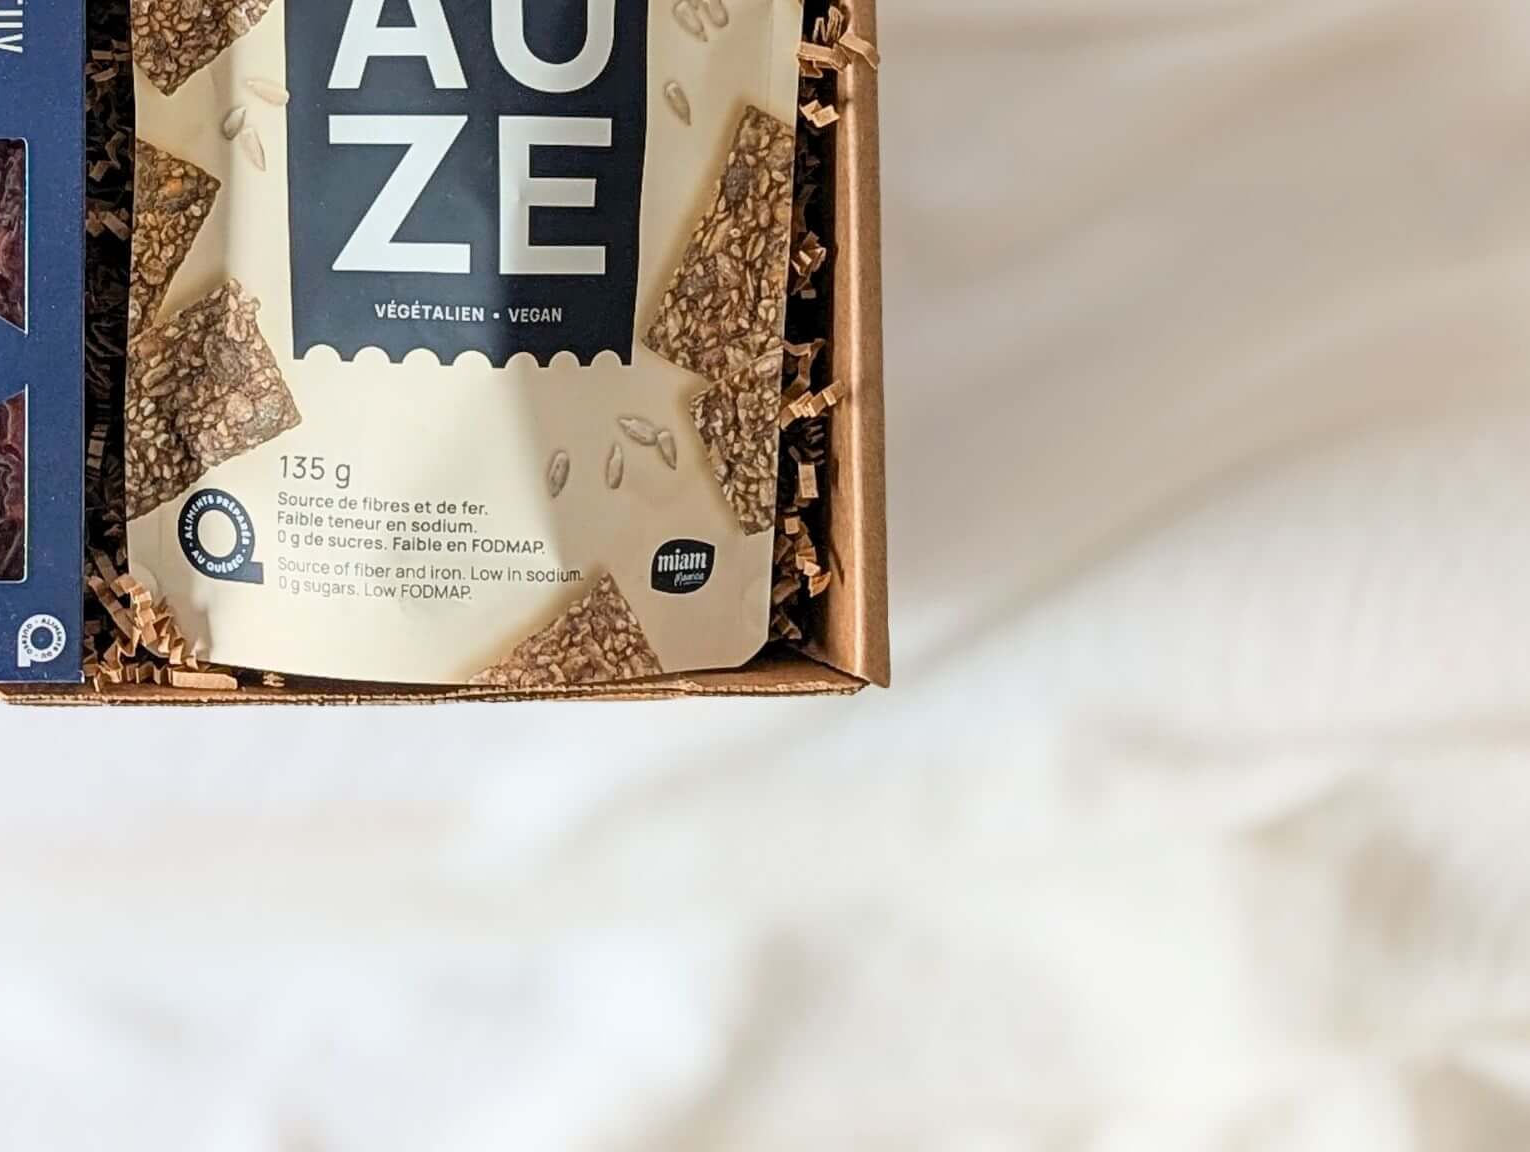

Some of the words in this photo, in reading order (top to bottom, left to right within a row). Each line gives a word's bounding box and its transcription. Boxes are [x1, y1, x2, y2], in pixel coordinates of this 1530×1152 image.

[328, 114, 613, 275] ZE
[374, 300, 484, 322] VÉGÉTALIEN
[508, 307, 562, 323] VEGAN
[280, 455, 325, 480] 135
[335, 463, 351, 489] g
[278, 491, 334, 509] Source
[338, 496, 358, 510] de
[362, 497, 410, 513] fibres
[414, 501, 432, 514] et
[436, 501, 457, 514] de
[462, 501, 488, 515] fer.
[185, 495, 214, 539] ALIMENTS
[216, 496, 251, 545] PRÉPARÉS
[278, 510, 324, 527] Faible
[328, 515, 382, 530] teneur
[386, 520, 406, 532] en
[411, 519, 478, 533] sodium.
[278, 529, 286, 543] 0
[290, 534, 300, 548] g
[304, 532, 324, 546] de
[328, 536, 387, 550] sucres.
[392, 536, 442, 551] Faible
[446, 540, 467, 552] en
[471, 539, 545, 554] FODMAP.
[191, 550, 205, 564] AU
[206, 554, 244, 573] QUÉBEC
[278, 556, 330, 575] Source
[334, 561, 351, 576] of
[354, 562, 391, 578] fiber
[395, 565, 426, 579] and
[431, 565, 466, 581] iron.
[471, 566, 503, 581] Low
[508, 567, 522, 581] in
[526, 568, 584, 583] sodium.
[657, 548, 707, 573] miam
[279, 575, 287, 589] 0
[291, 579, 300, 595] g
[303, 580, 360, 597] sugars.
[364, 582, 396, 598] Low
[400, 584, 472, 600] FODMAP.
